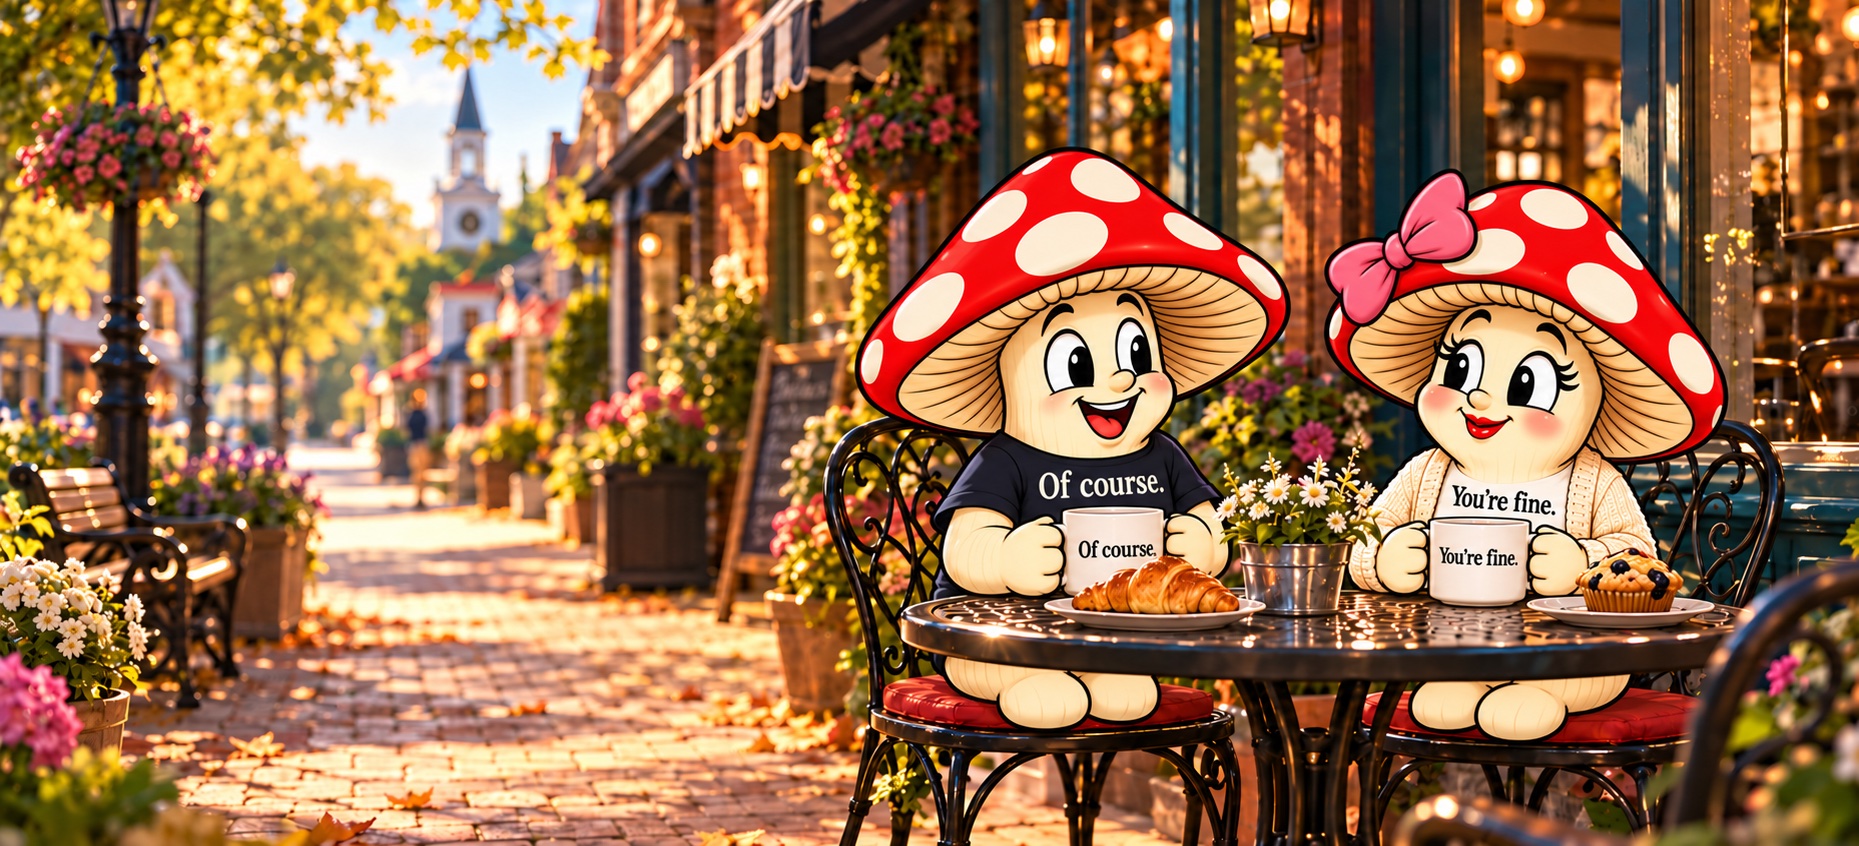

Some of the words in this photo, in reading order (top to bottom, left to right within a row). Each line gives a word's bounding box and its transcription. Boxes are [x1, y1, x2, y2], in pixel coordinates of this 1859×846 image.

[1039, 469, 1072, 500] Of
[1080, 474, 1165, 498] course.
[1452, 485, 1508, 512] You’re
[1513, 490, 1556, 516] fine.
[1078, 540, 1099, 558] Of
[1439, 547, 1483, 566] You’re
[1486, 548, 1518, 566] fine.
